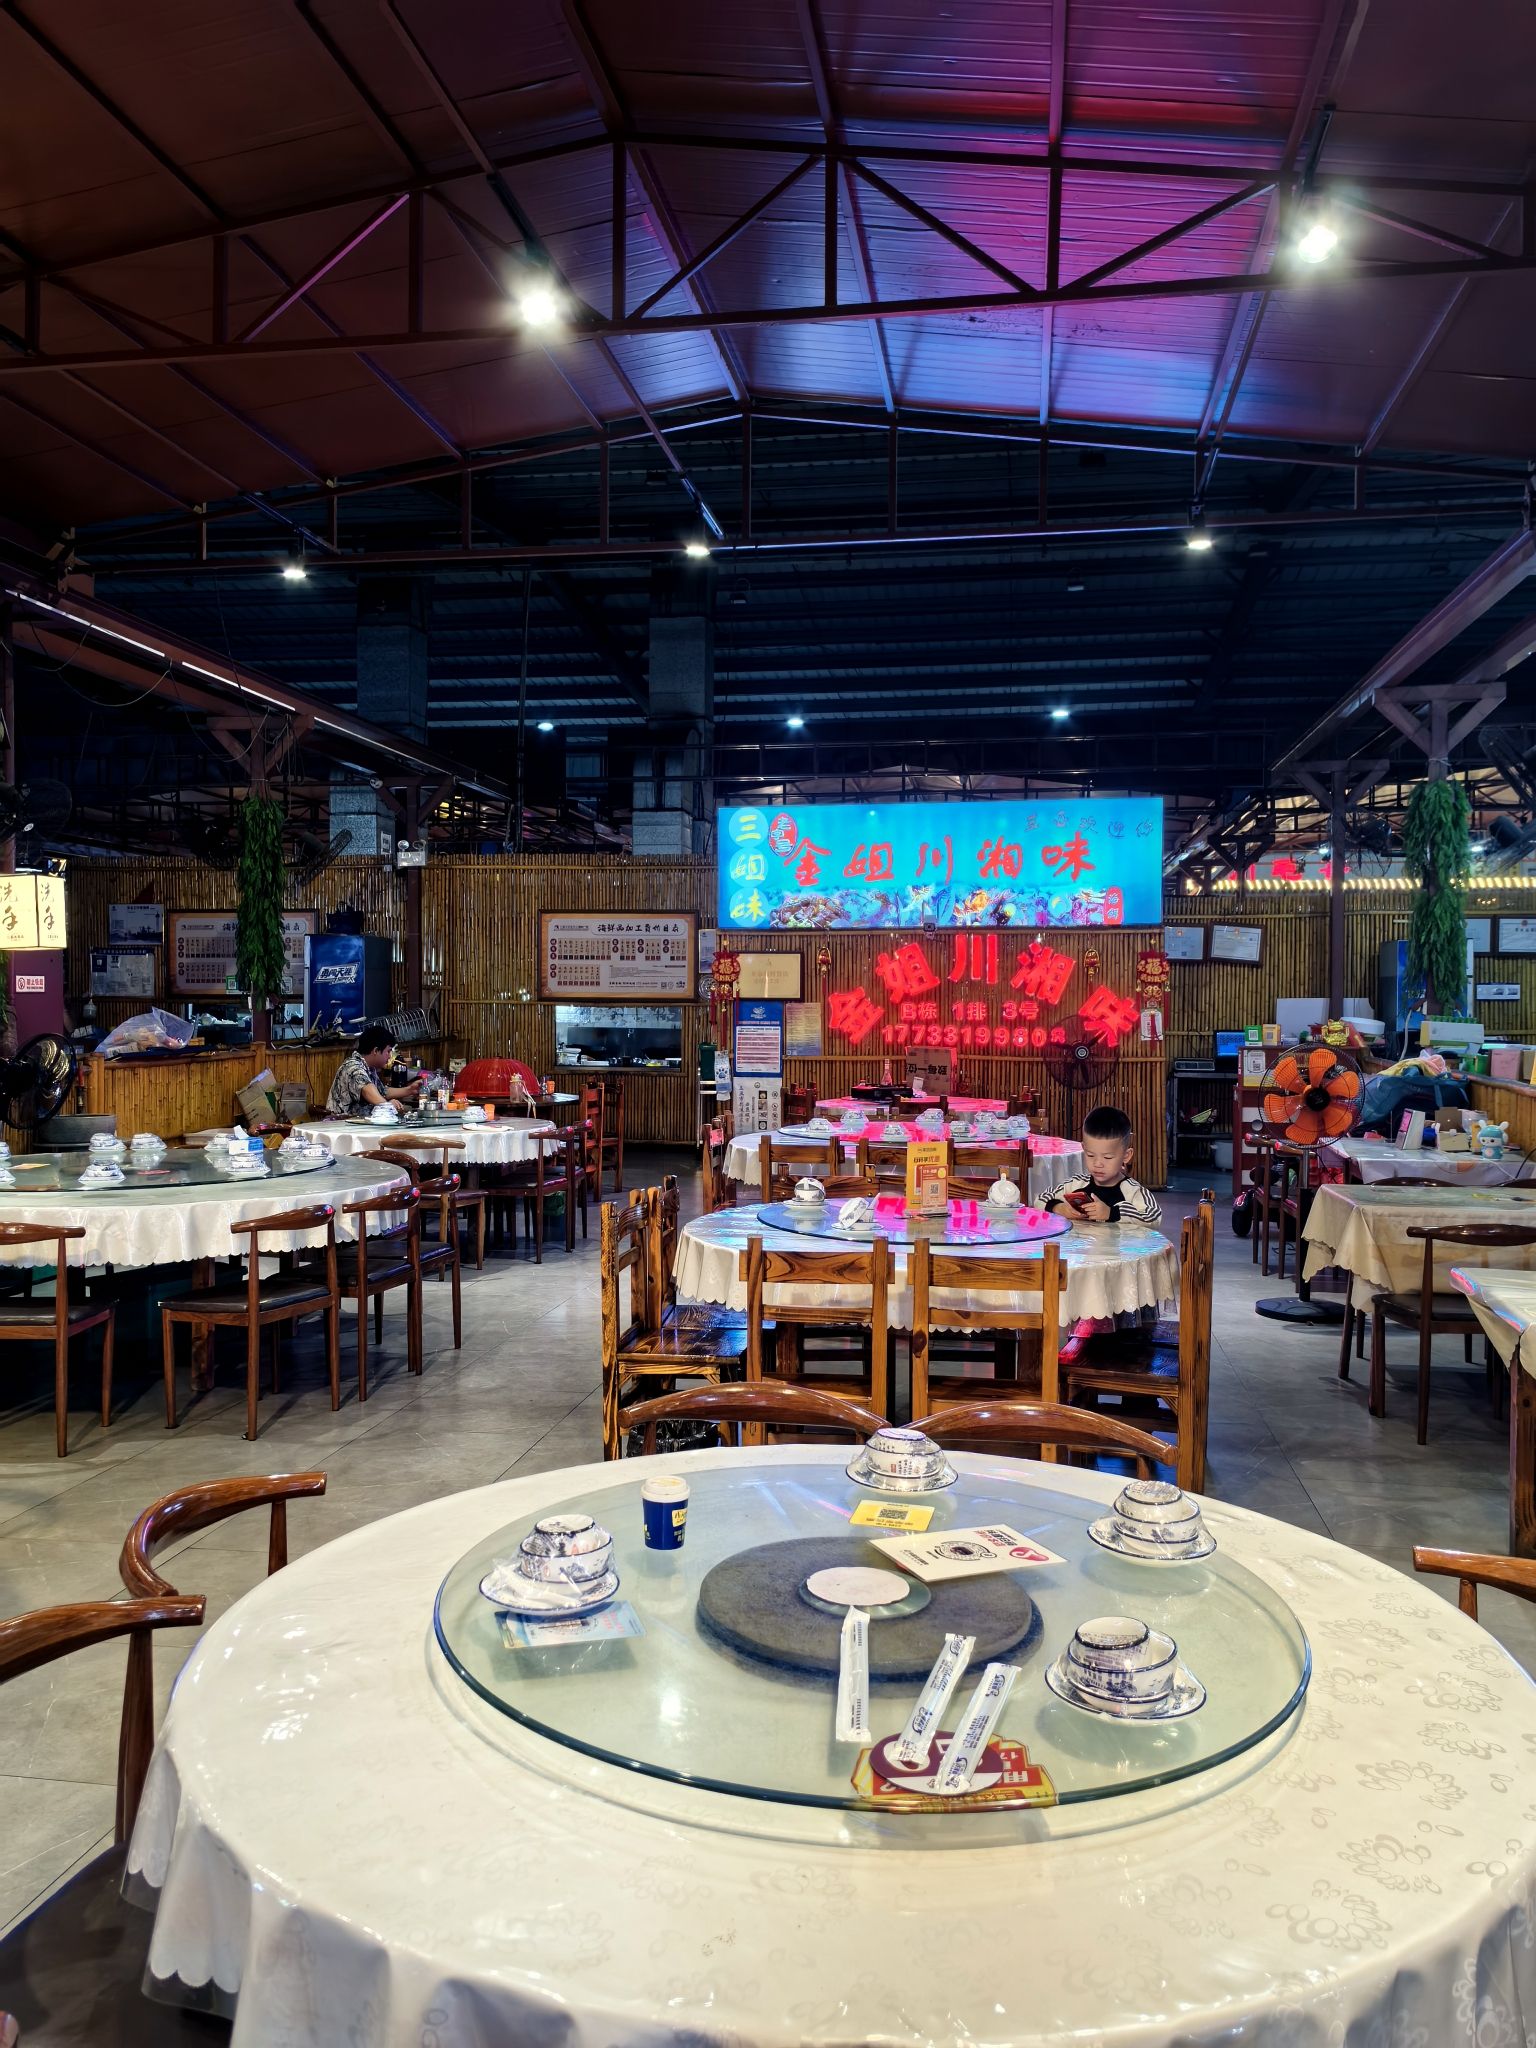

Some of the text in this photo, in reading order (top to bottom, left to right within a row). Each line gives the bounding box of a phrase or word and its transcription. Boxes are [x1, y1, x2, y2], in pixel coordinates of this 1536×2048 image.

[783, 830, 1097, 887] 金姐川湘味
